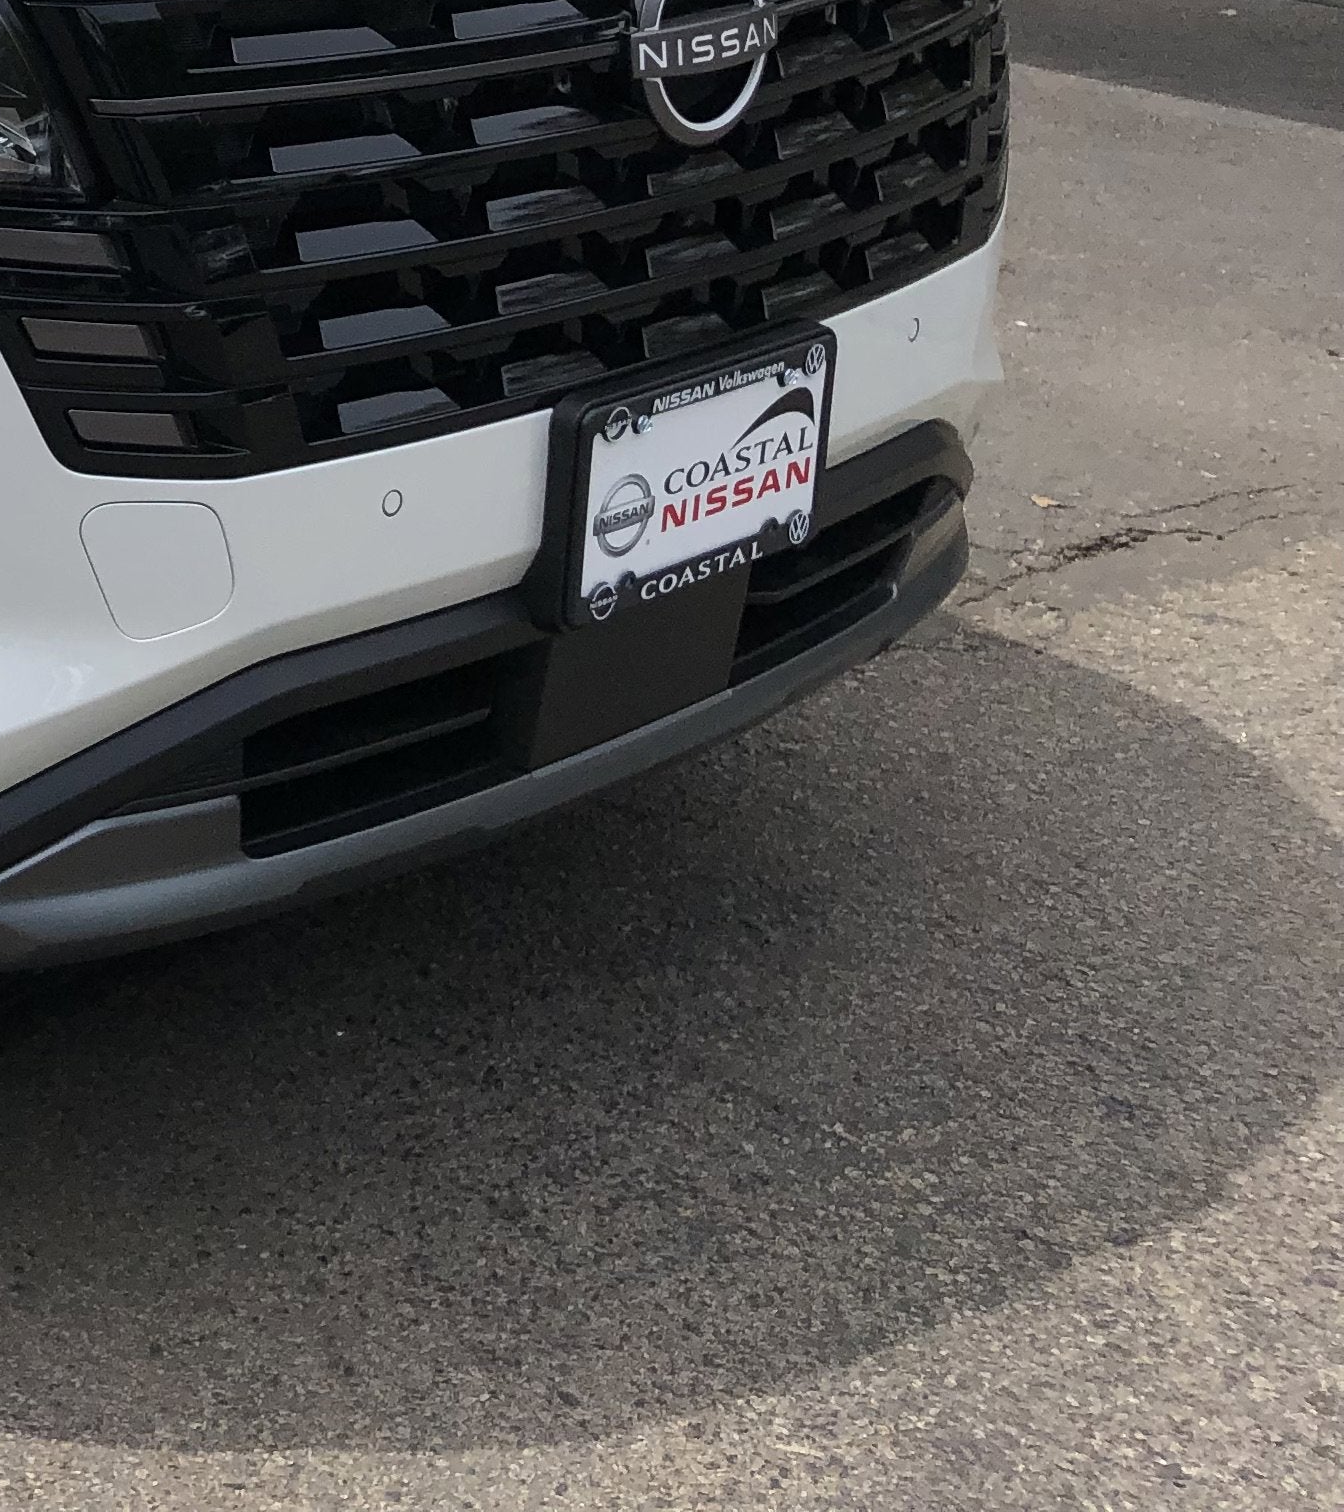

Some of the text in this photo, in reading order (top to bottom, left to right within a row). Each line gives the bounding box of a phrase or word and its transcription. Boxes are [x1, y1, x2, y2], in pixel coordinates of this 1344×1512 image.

[638, 14, 777, 71] NISSAN
[652, 360, 785, 414] NISSAN Volkswagen
[664, 426, 813, 495] COASTAL
[598, 501, 650, 528] NISSAN
[661, 456, 811, 533] NISSAN
[640, 541, 763, 600] COASTAL
